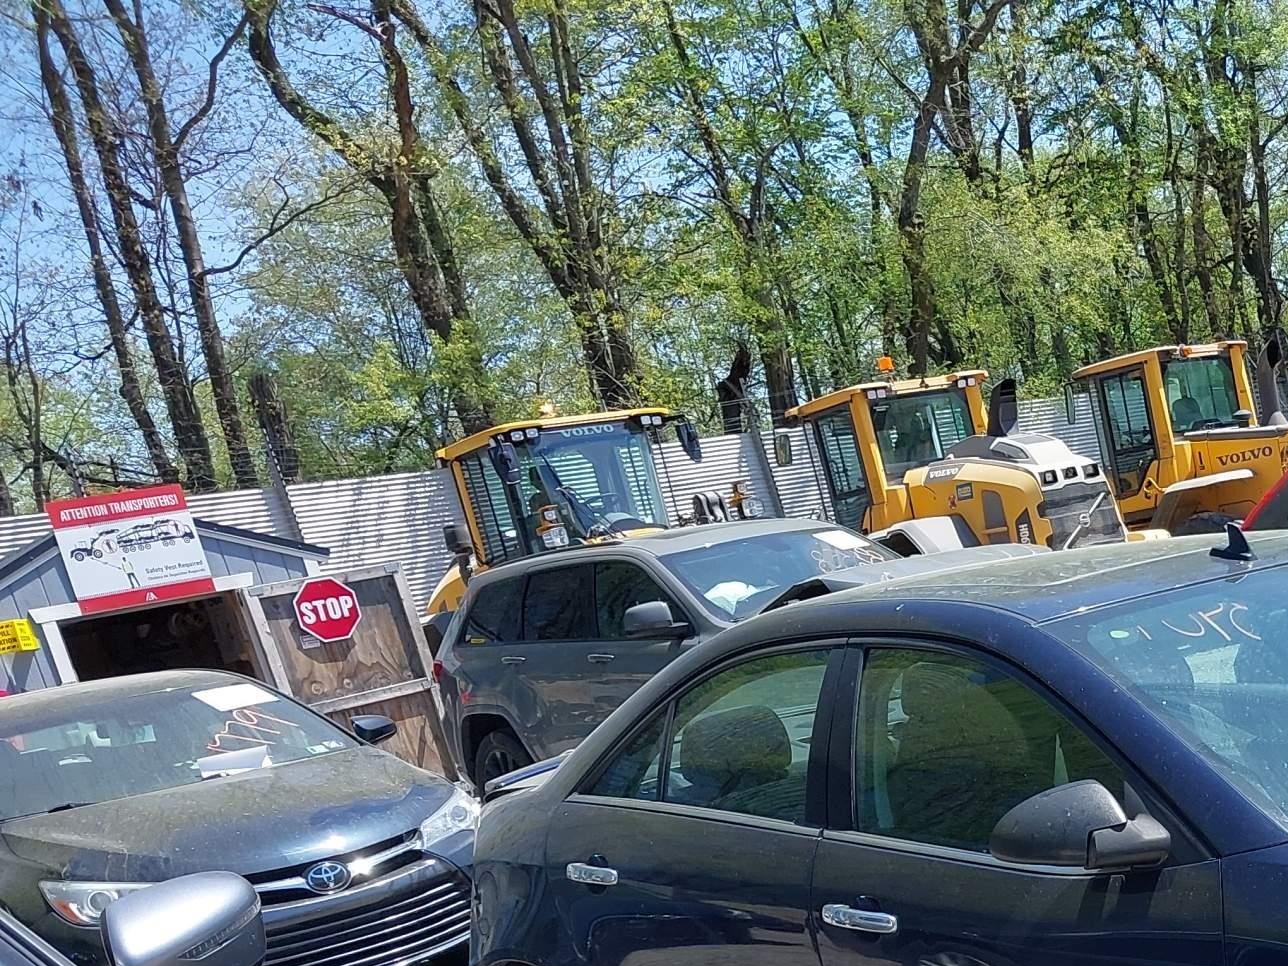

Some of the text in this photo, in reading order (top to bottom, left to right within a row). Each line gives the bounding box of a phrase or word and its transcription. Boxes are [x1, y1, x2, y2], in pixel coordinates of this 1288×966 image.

[561, 424, 615, 438] VOLVO
[1216, 446, 1273, 466] VOLVO
[929, 467, 959, 479] VOLVO
[60, 493, 179, 522] ATTENTION TRANSPORTERS!
[300, 595, 353, 625] STOP
